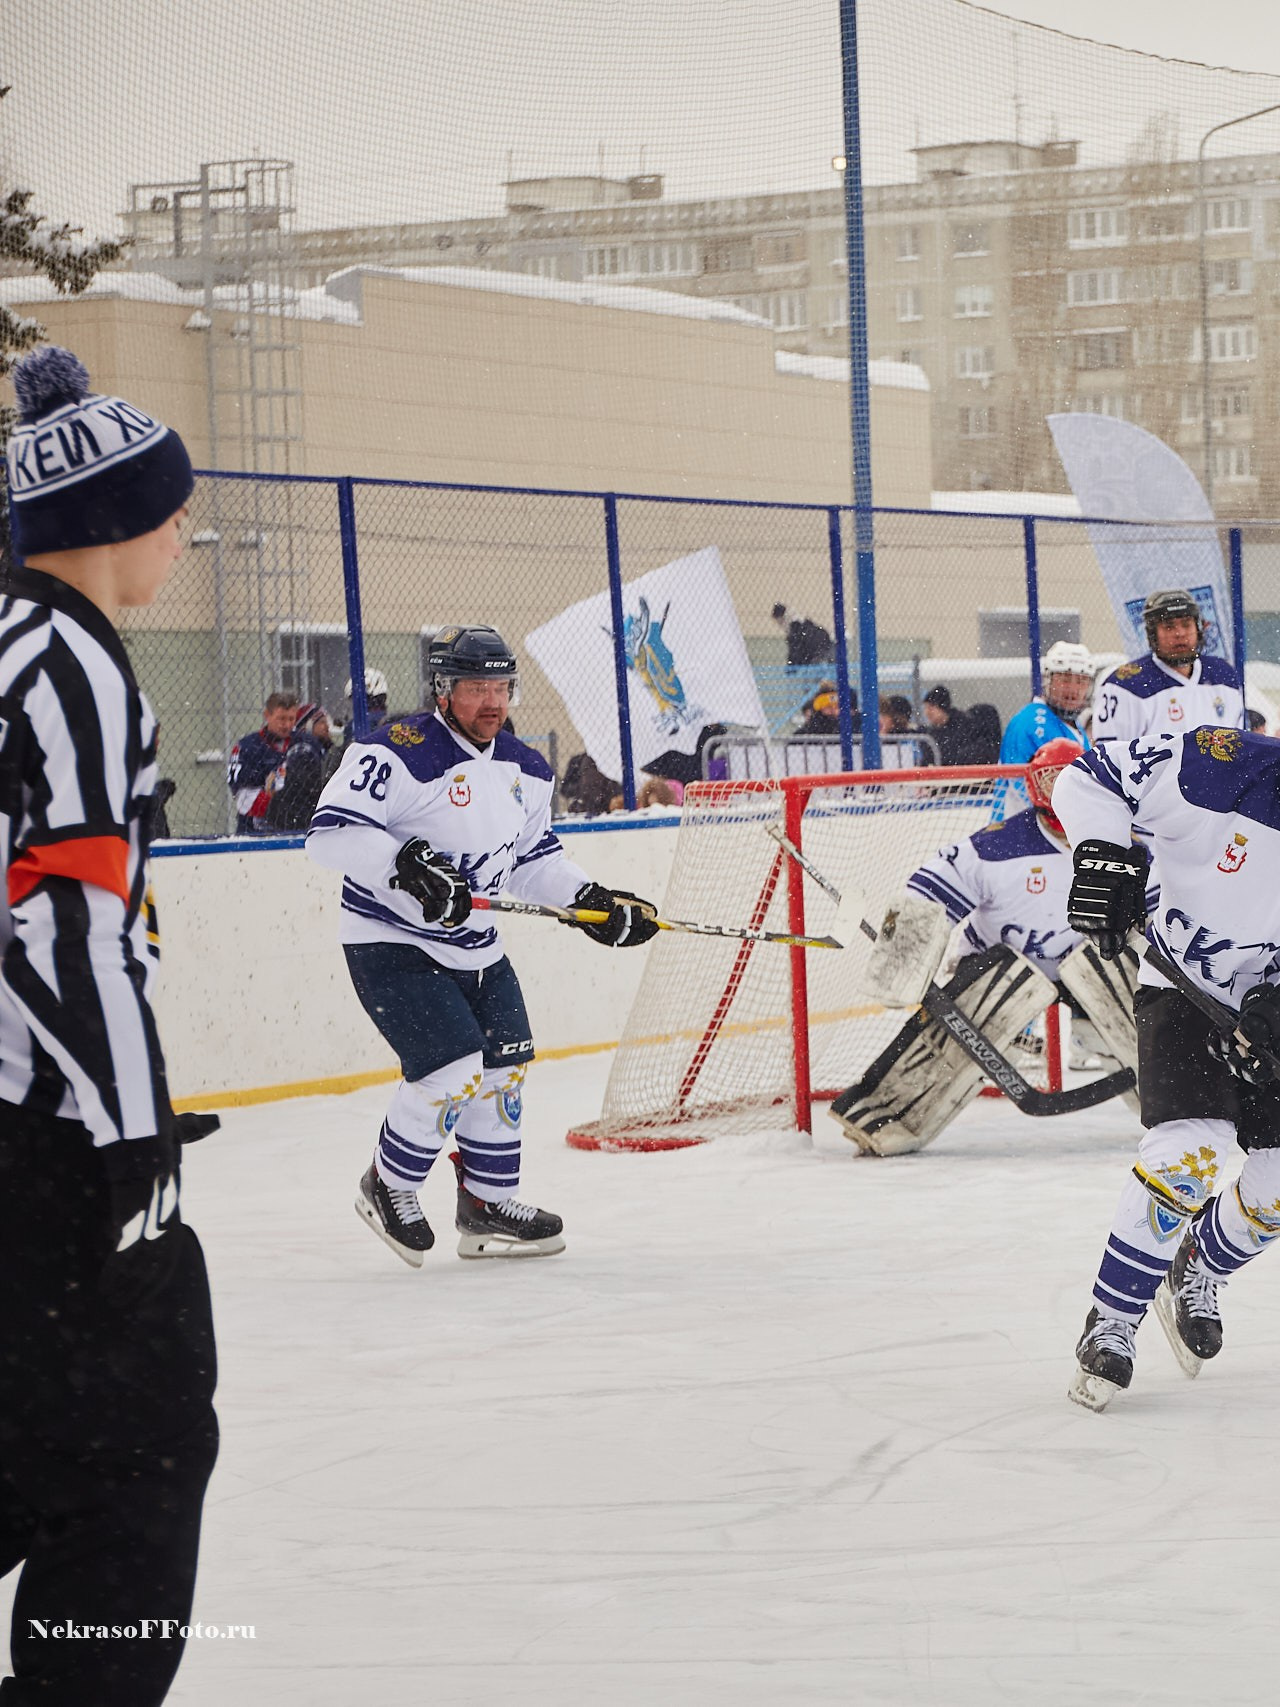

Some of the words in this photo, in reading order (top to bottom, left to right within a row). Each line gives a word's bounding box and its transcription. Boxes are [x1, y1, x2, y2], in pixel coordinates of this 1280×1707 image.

[1098, 693, 1118, 723] 37
[349, 754, 392, 802] 38
[1078, 858, 1142, 877] STEX
[500, 901, 541, 912] CCM
